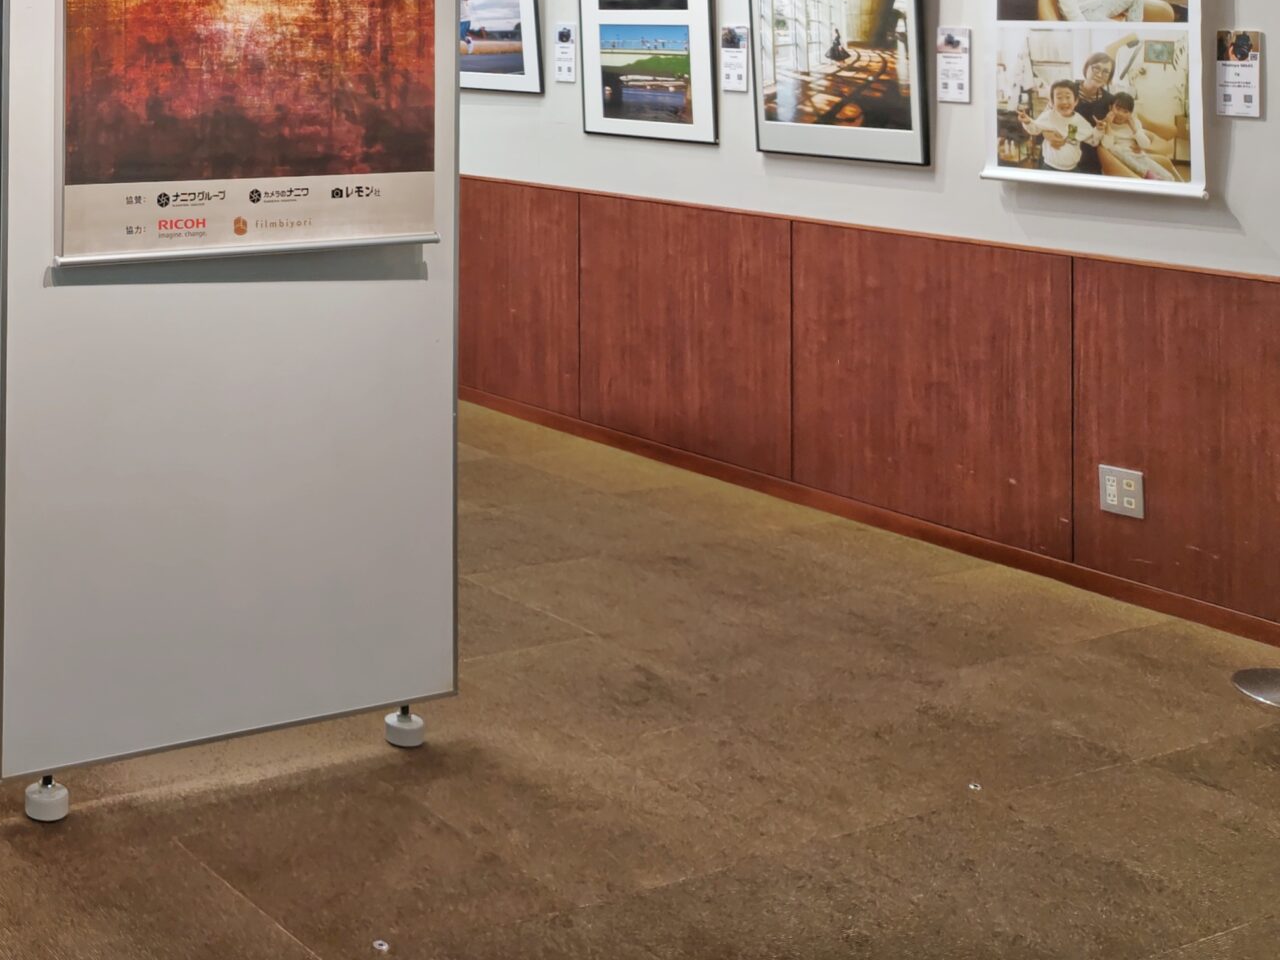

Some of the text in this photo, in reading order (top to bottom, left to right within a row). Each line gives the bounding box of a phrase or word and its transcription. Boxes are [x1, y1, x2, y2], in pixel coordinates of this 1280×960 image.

[171, 189, 226, 202] ナニワグループ
[263, 187, 310, 199] カメラのナニワ
[158, 218, 207, 231] RICOH
[255, 217, 313, 229] filmbiyori
